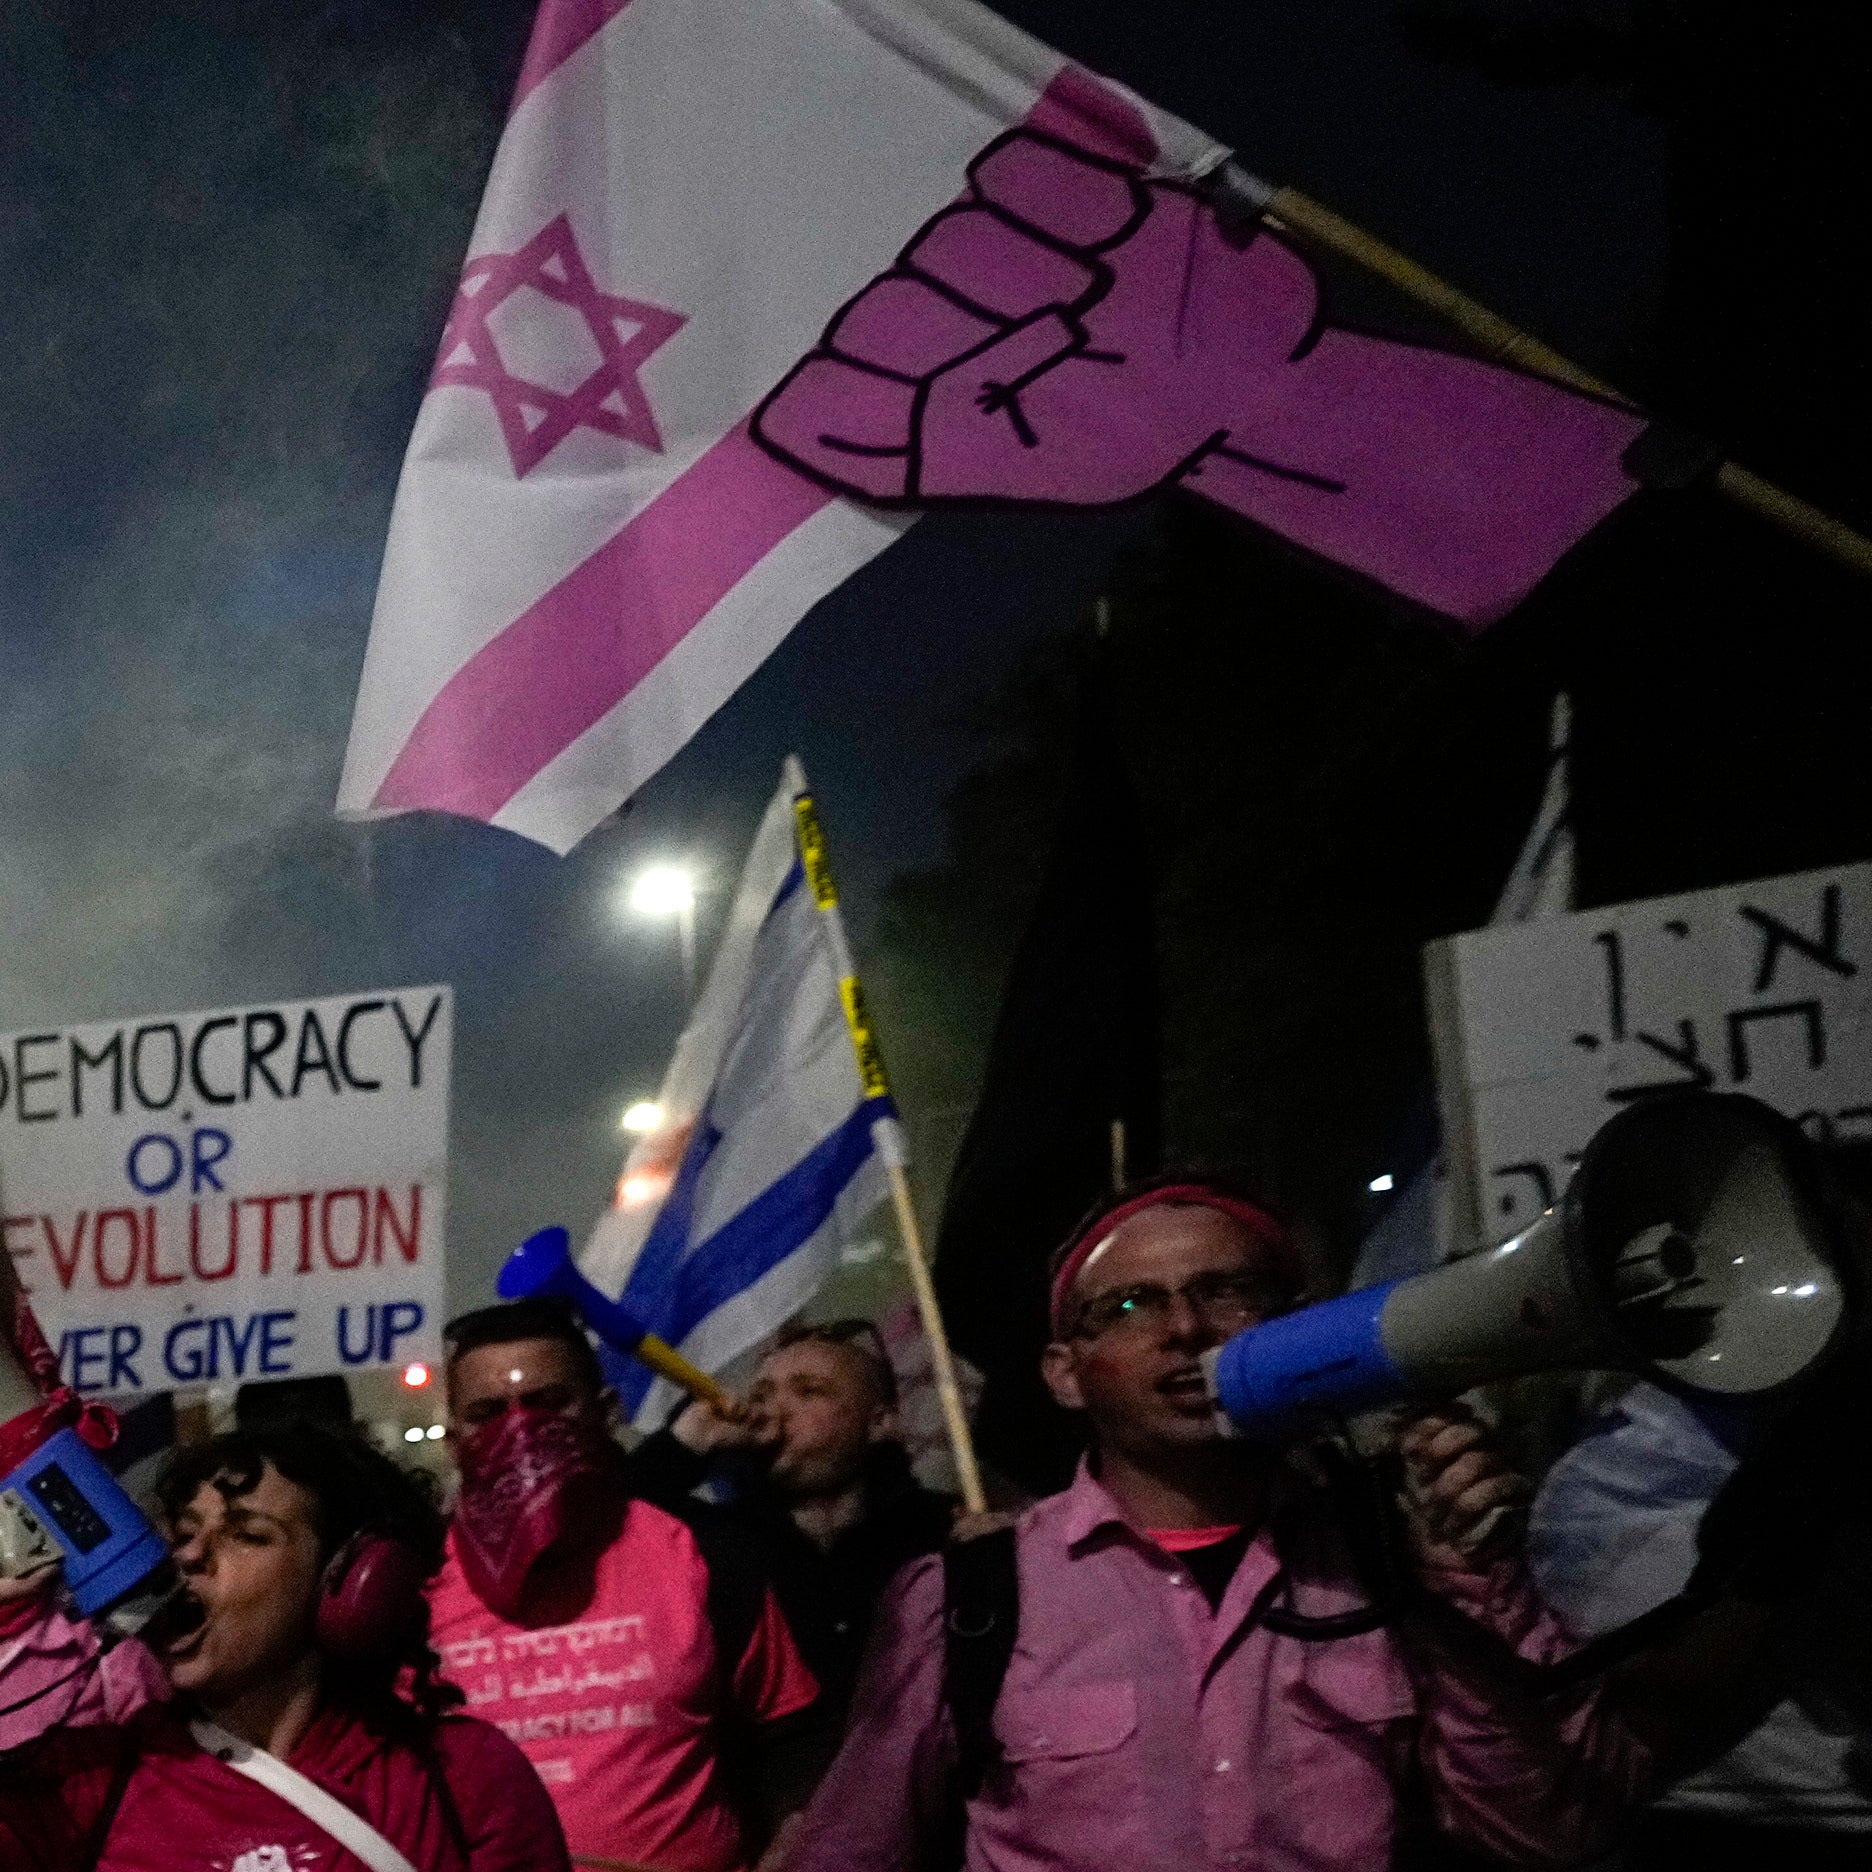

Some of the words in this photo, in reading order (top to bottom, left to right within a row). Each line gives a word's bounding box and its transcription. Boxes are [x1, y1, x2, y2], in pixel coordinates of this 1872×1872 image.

[128, 1129, 233, 1195] OR
[0, 1186, 422, 1292] EVOLUTION
[59, 1325, 141, 1391] VER
[166, 1313, 295, 1381] GIVE
[338, 1303, 423, 1364] UP
